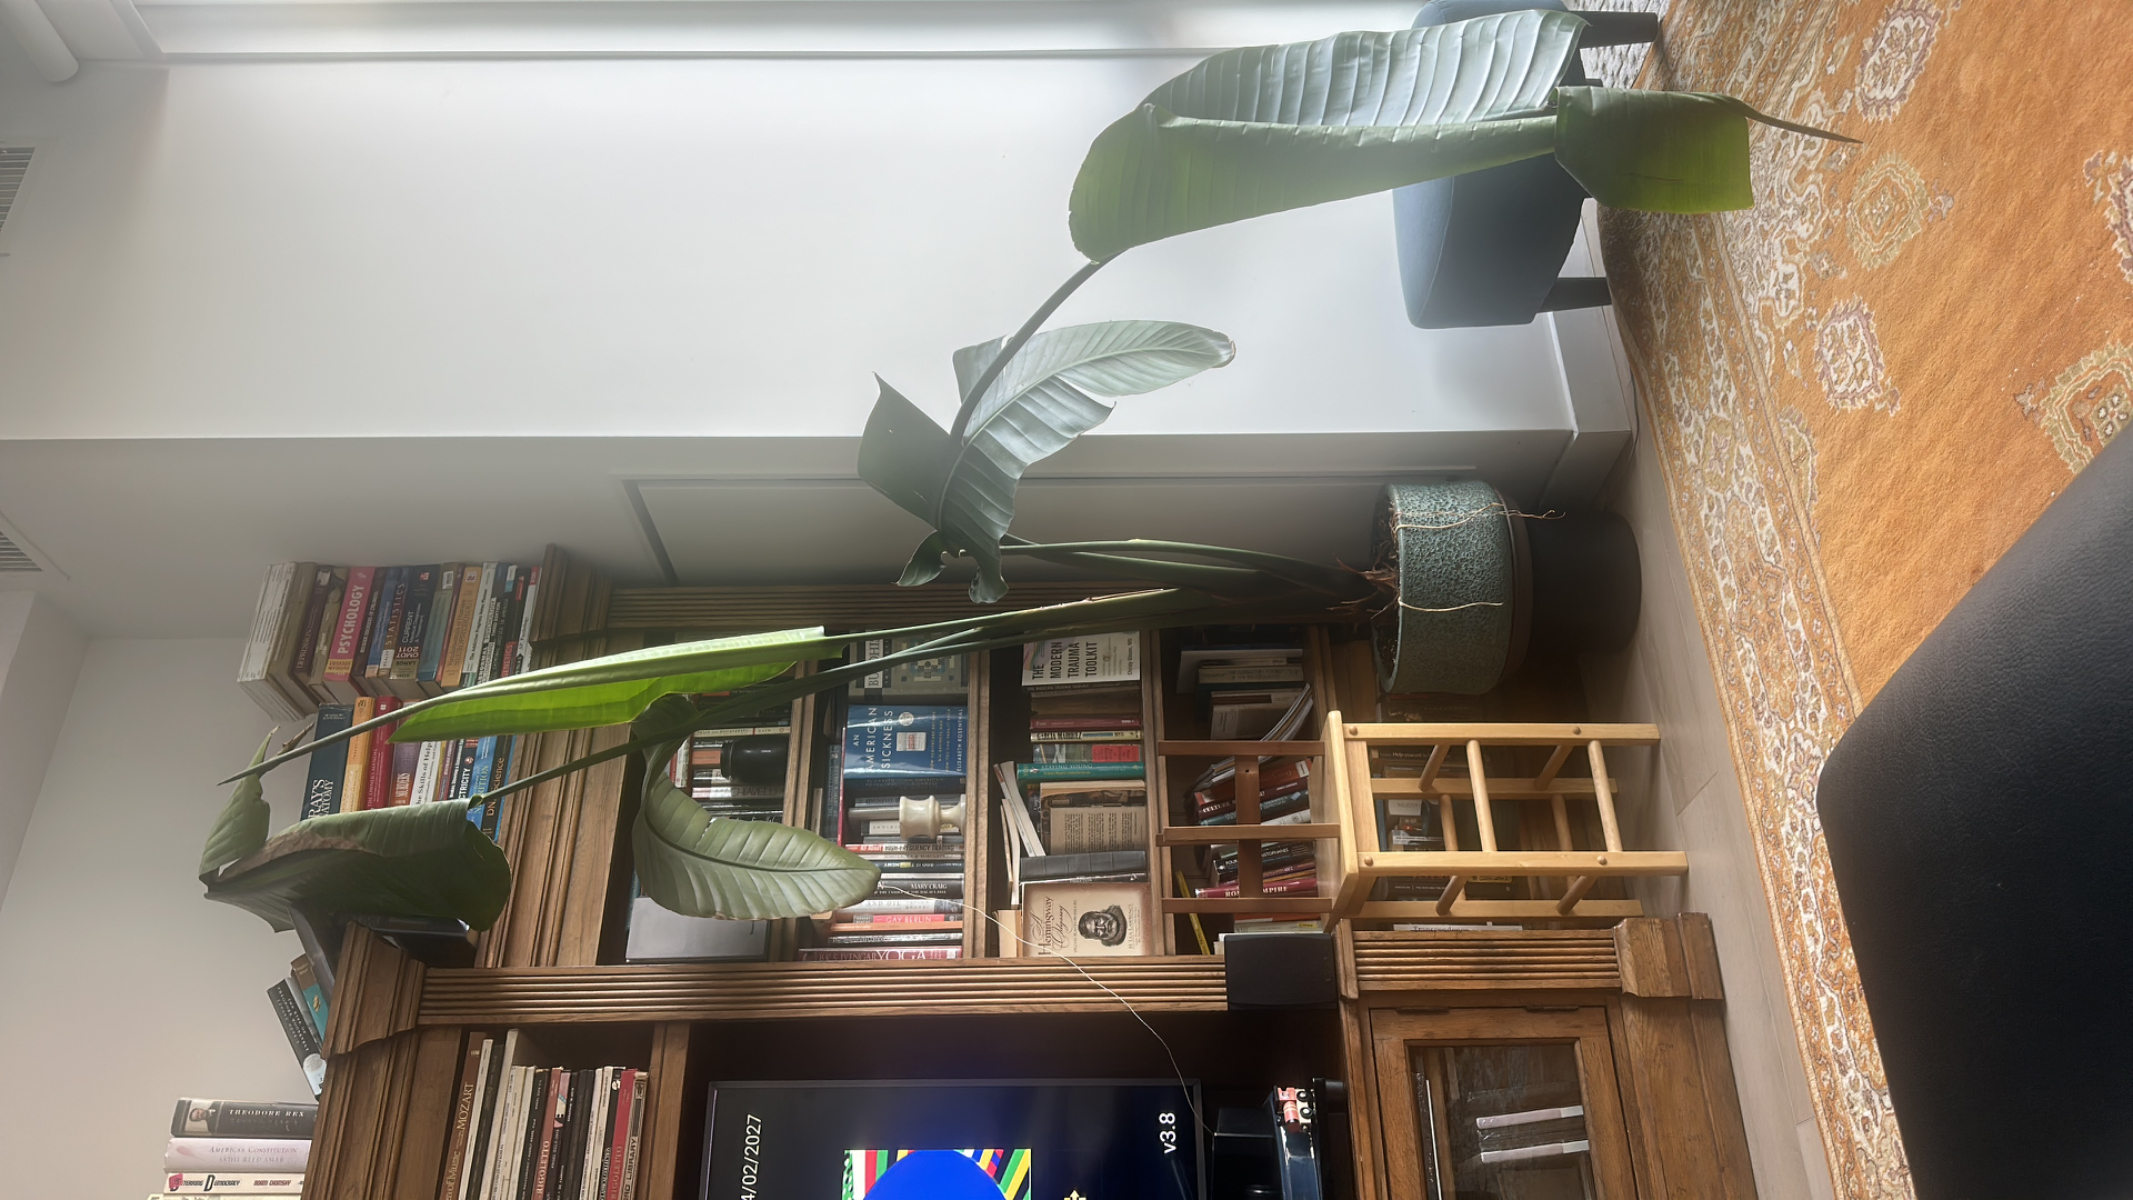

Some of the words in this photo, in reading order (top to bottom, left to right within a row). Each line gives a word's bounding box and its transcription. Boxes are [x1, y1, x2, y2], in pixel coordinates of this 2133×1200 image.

[337, 585, 364, 654] PSYCHOLOGY
[385, 583, 405, 646] STATISTICS
[402, 611, 415, 643] CURRENT
[1032, 664, 1045, 680] THE
[1050, 641, 1063, 679] MODERN
[1067, 642, 1080, 679] TRAUMA
[1085, 641, 1098, 678] TOOLKIT
[423, 742, 432, 761] Help
[853, 734, 860, 747] AN
[865, 707, 878, 771] AMERICAN
[881, 710, 893, 769] SICKNESS
[417, 771, 426, 794] Skills
[421, 762, 427, 770] of
[457, 767, 471, 799] CTRICITY
[307, 777, 324, 818] RAY'S
[320, 779, 333, 813] ATOMY
[1263, 885, 1288, 895] MPIRE
[886, 916, 903, 924] GAY
[905, 915, 932, 923] BERLIN
[1038, 897, 1054, 955] Hemingway
[876, 950, 926, 960] YOGA
[455, 1081, 474, 1129] MOZART
[1158, 1112, 1177, 1154] v3.8
[448, 1150, 461, 1179] Music
[536, 1139, 550, 1193] RIGOLETTO
[610, 1145, 623, 1198] RIGOLETTO
[626, 1138, 636, 1180] LIBRARY
[741, 1114, 762, 1200] 4/02/2027
[445, 1178, 454, 1191] of
